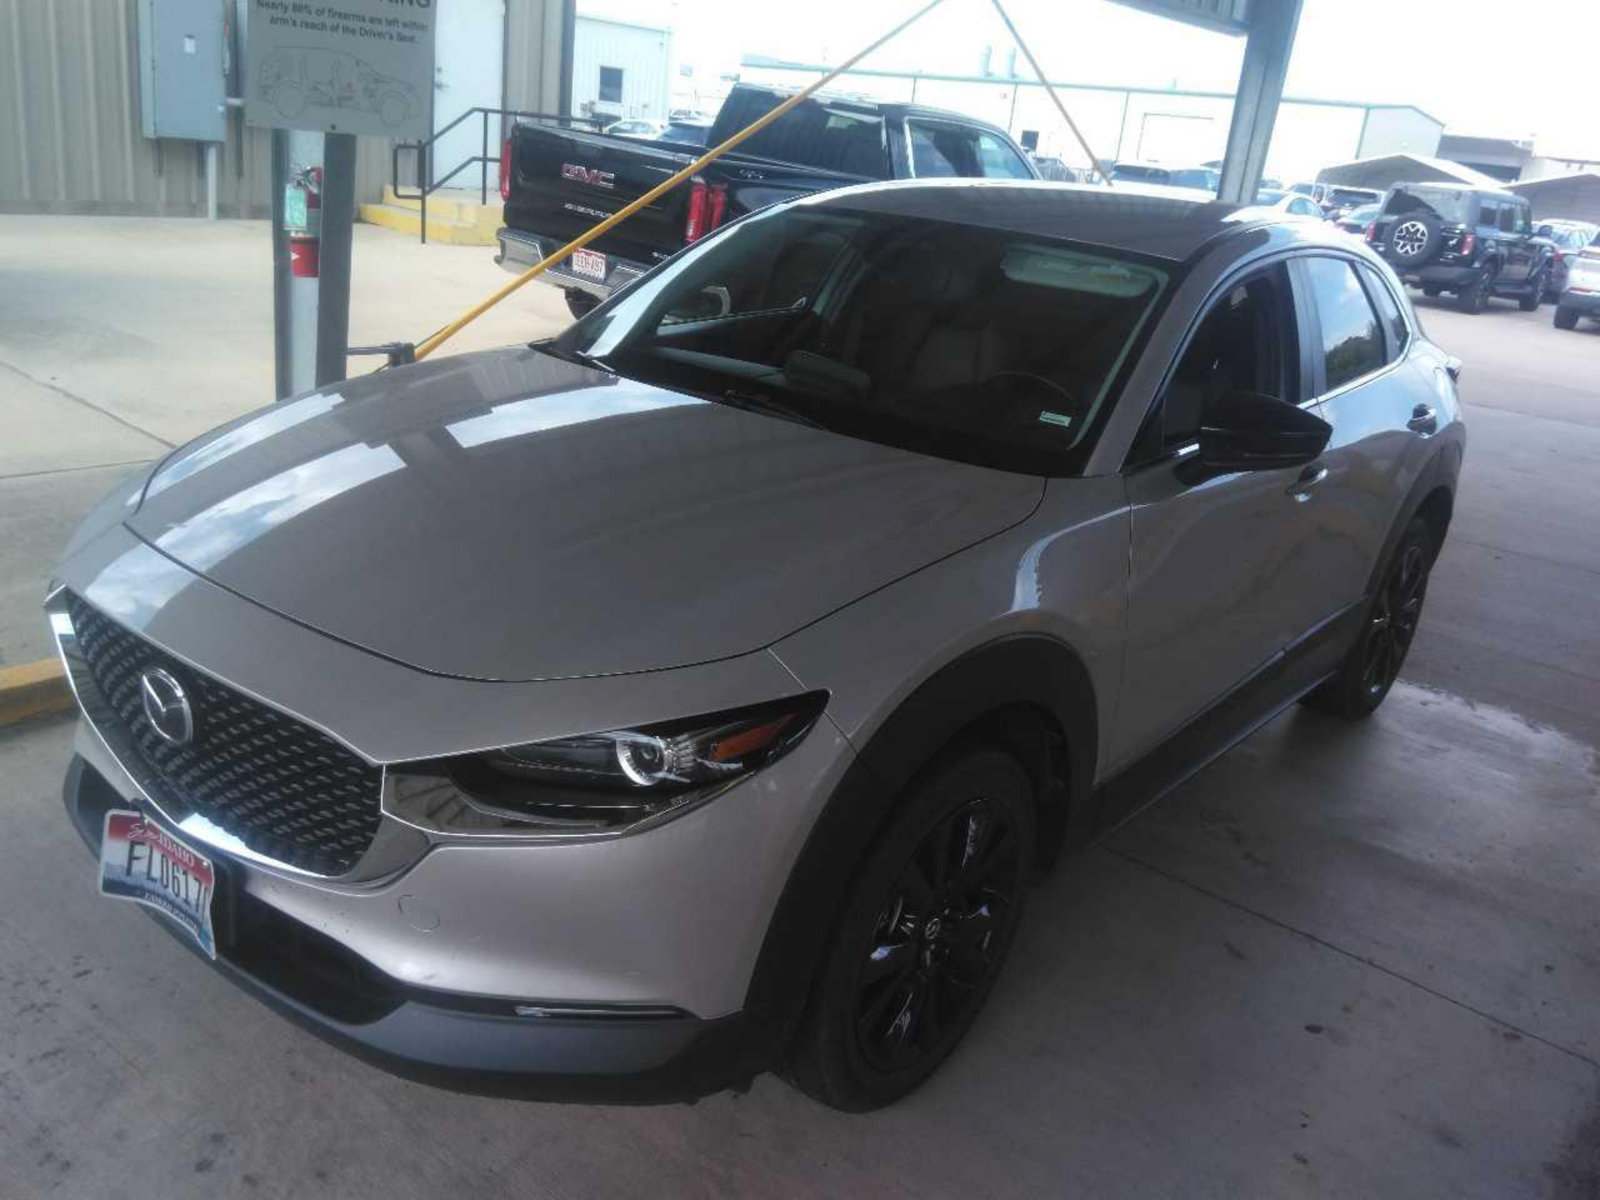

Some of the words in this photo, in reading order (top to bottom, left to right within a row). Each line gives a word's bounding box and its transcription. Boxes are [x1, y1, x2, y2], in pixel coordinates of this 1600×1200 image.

[269, 16, 297, 27] arm's
[300, 19, 327, 31] reach
[330, 22, 340, 32] of
[342, 24, 357, 36] the
[359, 27, 394, 41] Driver's
[315, 8, 325, 17] of
[328, 8, 366, 23] firearms
[368, 16, 383, 25] are
[385, 17, 399, 28] left
[561, 163, 615, 189] GMC
[159, 833, 196, 867] IDAHO
